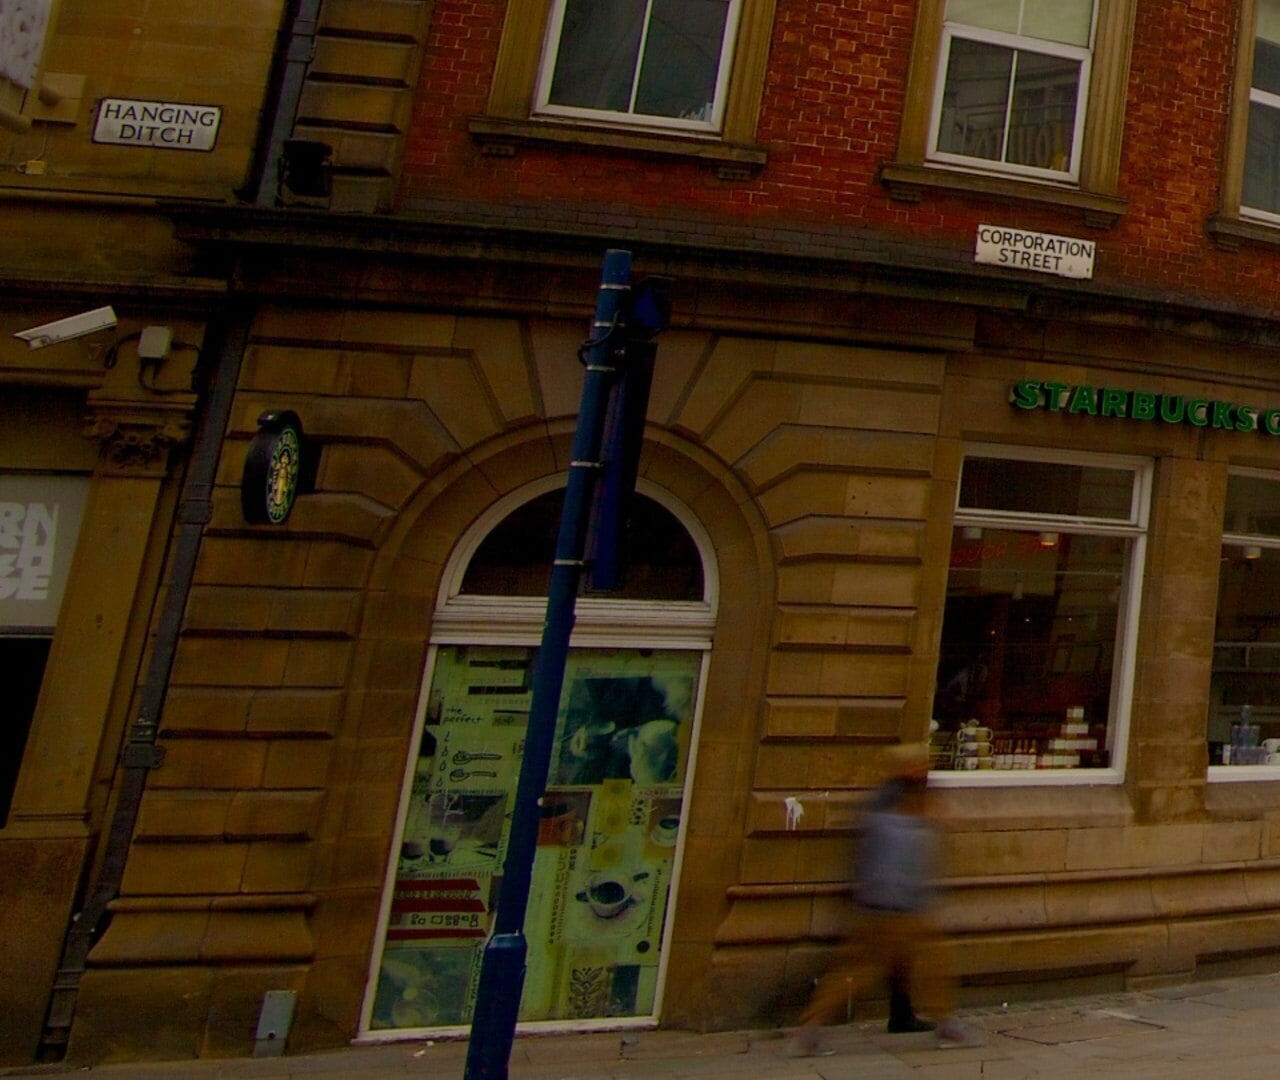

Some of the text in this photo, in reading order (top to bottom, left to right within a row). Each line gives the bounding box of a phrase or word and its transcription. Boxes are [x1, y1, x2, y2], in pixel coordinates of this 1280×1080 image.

[104, 103, 216, 127] HANGING
[119, 123, 194, 144] DITCH
[980, 229, 1093, 258] CORPORATION
[998, 248, 1063, 270] STREET
[1012, 379, 1256, 433] STARBUCKS
